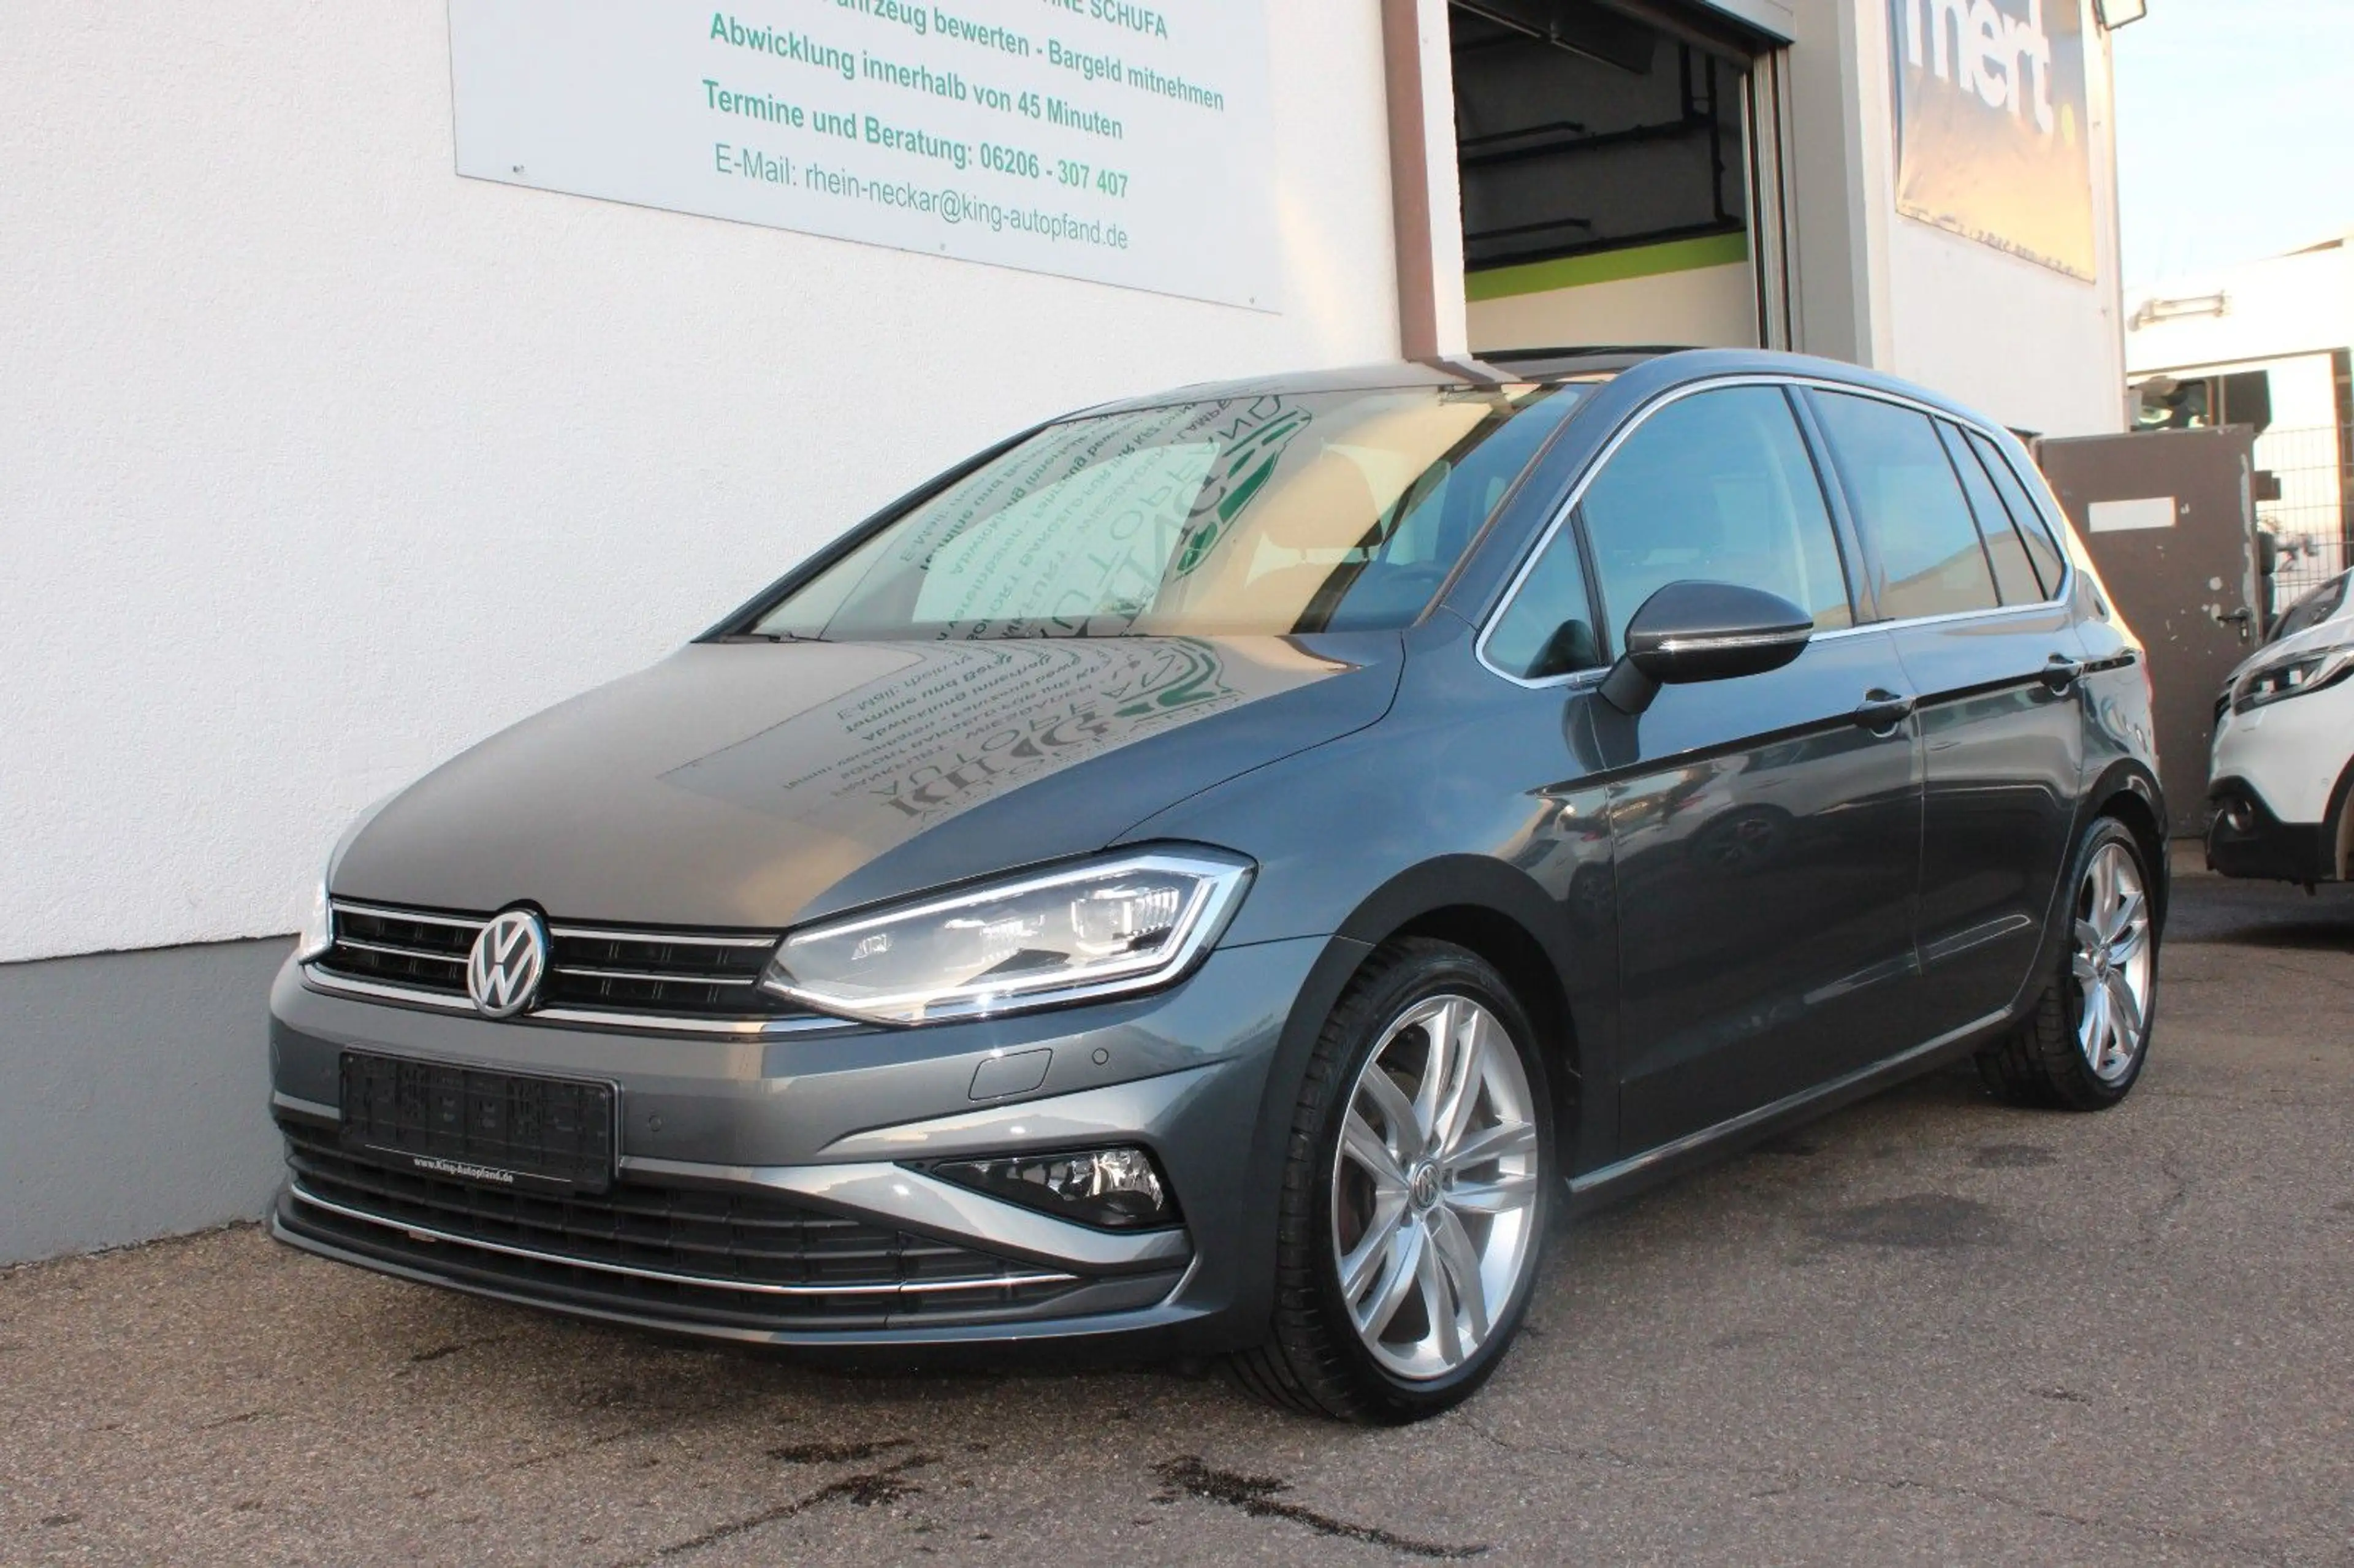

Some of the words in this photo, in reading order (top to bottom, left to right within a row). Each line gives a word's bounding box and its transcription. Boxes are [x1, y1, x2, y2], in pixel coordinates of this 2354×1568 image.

[934, 7, 1029, 56] bewerten
[1049, 39, 1122, 82] Bargeld
[1127, 67, 1224, 112] mitnehmen
[1090, 0, 1168, 39] SCHUFA
[710, 12, 855, 80] Abwicklung
[863, 50, 967, 101] innerhalb
[973, 83, 1011, 113] von
[1018, 91, 1041, 119] 45
[1047, 96, 1122, 140] Minuten
[703, 78, 804, 128] Termine
[813, 113, 857, 140] und
[865, 115, 973, 170] Beratung:
[980, 142, 1040, 179] 06206
[1057, 159, 1090, 189] 307
[1097, 169, 1128, 198] 407
[715, 142, 798, 186] E-Mail:
[806, 162, 1129, 249] rhein-neckar@king-autopfand.de
